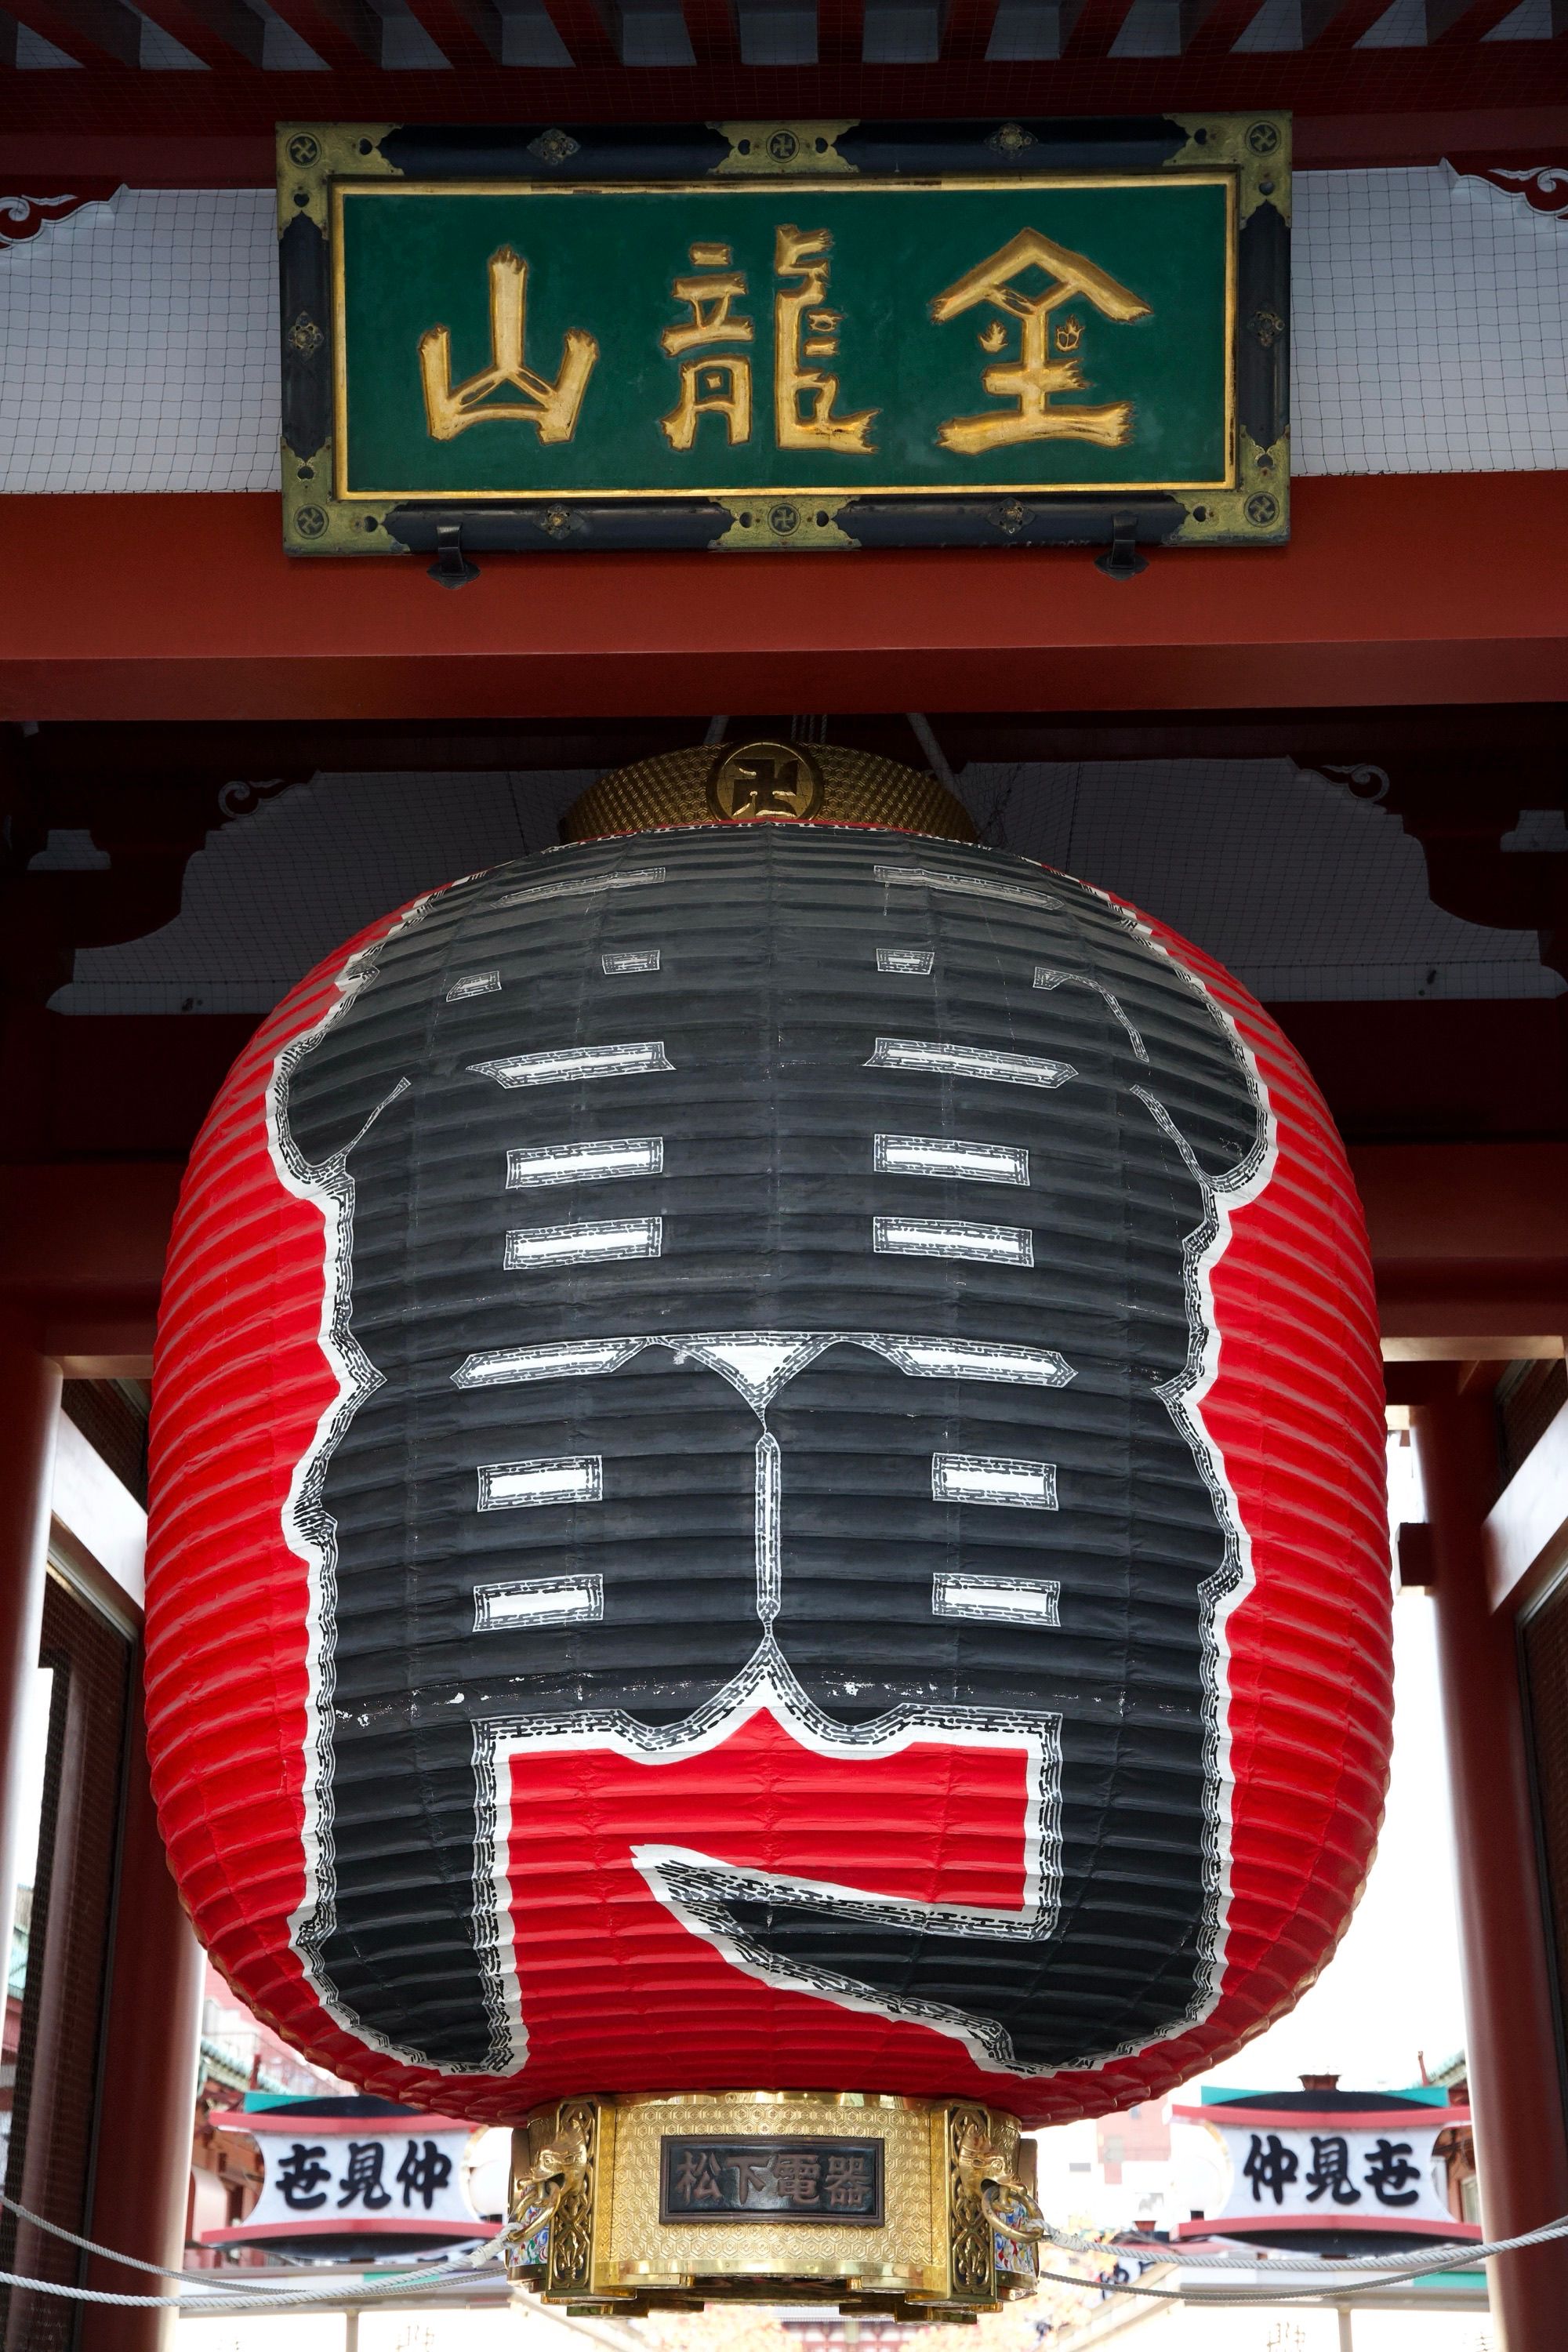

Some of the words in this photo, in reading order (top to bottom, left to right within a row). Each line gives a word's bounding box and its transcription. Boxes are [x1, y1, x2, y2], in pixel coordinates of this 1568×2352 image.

[417, 223, 1153, 455] 金龍山
[265, 826, 1279, 2079] 雷門
[675, 2151, 872, 2207] 松下電器
[1243, 2134, 1421, 2207] 仲見世
